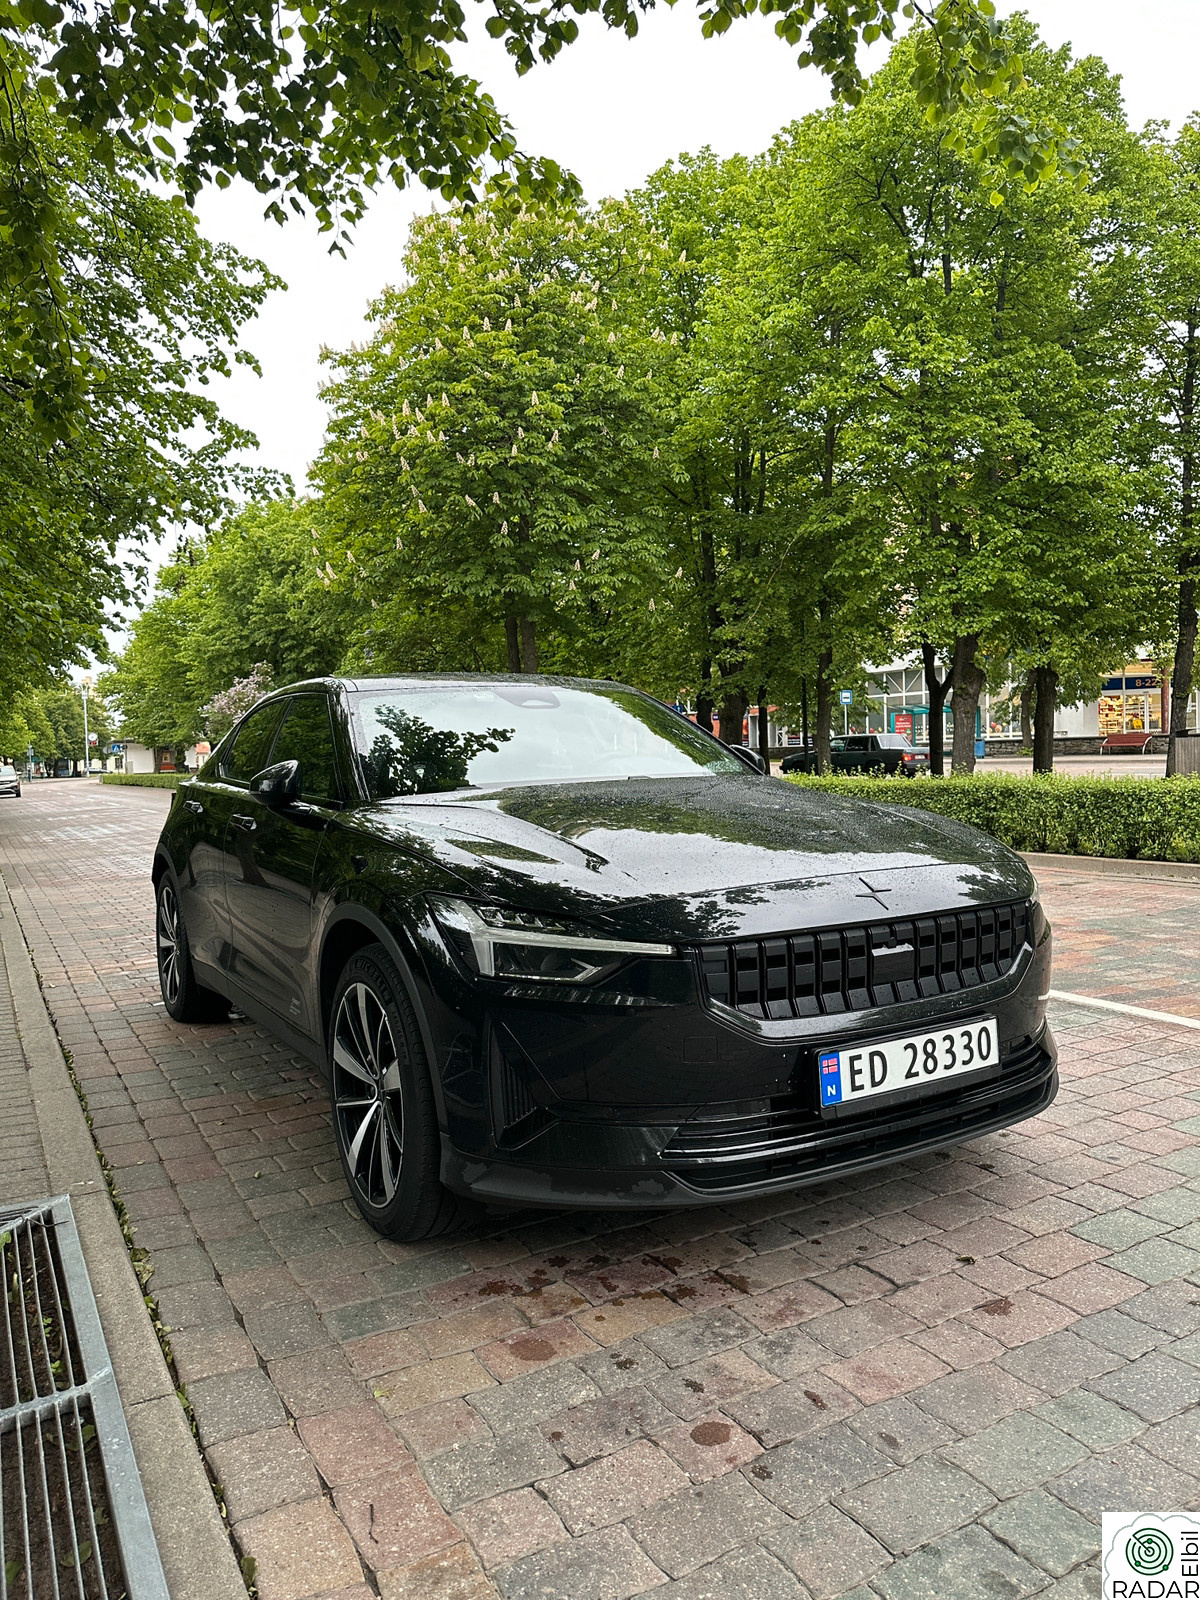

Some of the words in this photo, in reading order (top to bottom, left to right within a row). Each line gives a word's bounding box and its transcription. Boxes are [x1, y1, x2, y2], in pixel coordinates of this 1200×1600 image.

[1135, 678, 1157, 687] 8-22
[355, 959, 392, 1004] MICHELIN
[849, 1050, 888, 1092] ED
[903, 1026, 992, 1080] 28330
[827, 1085, 836, 1096] N
